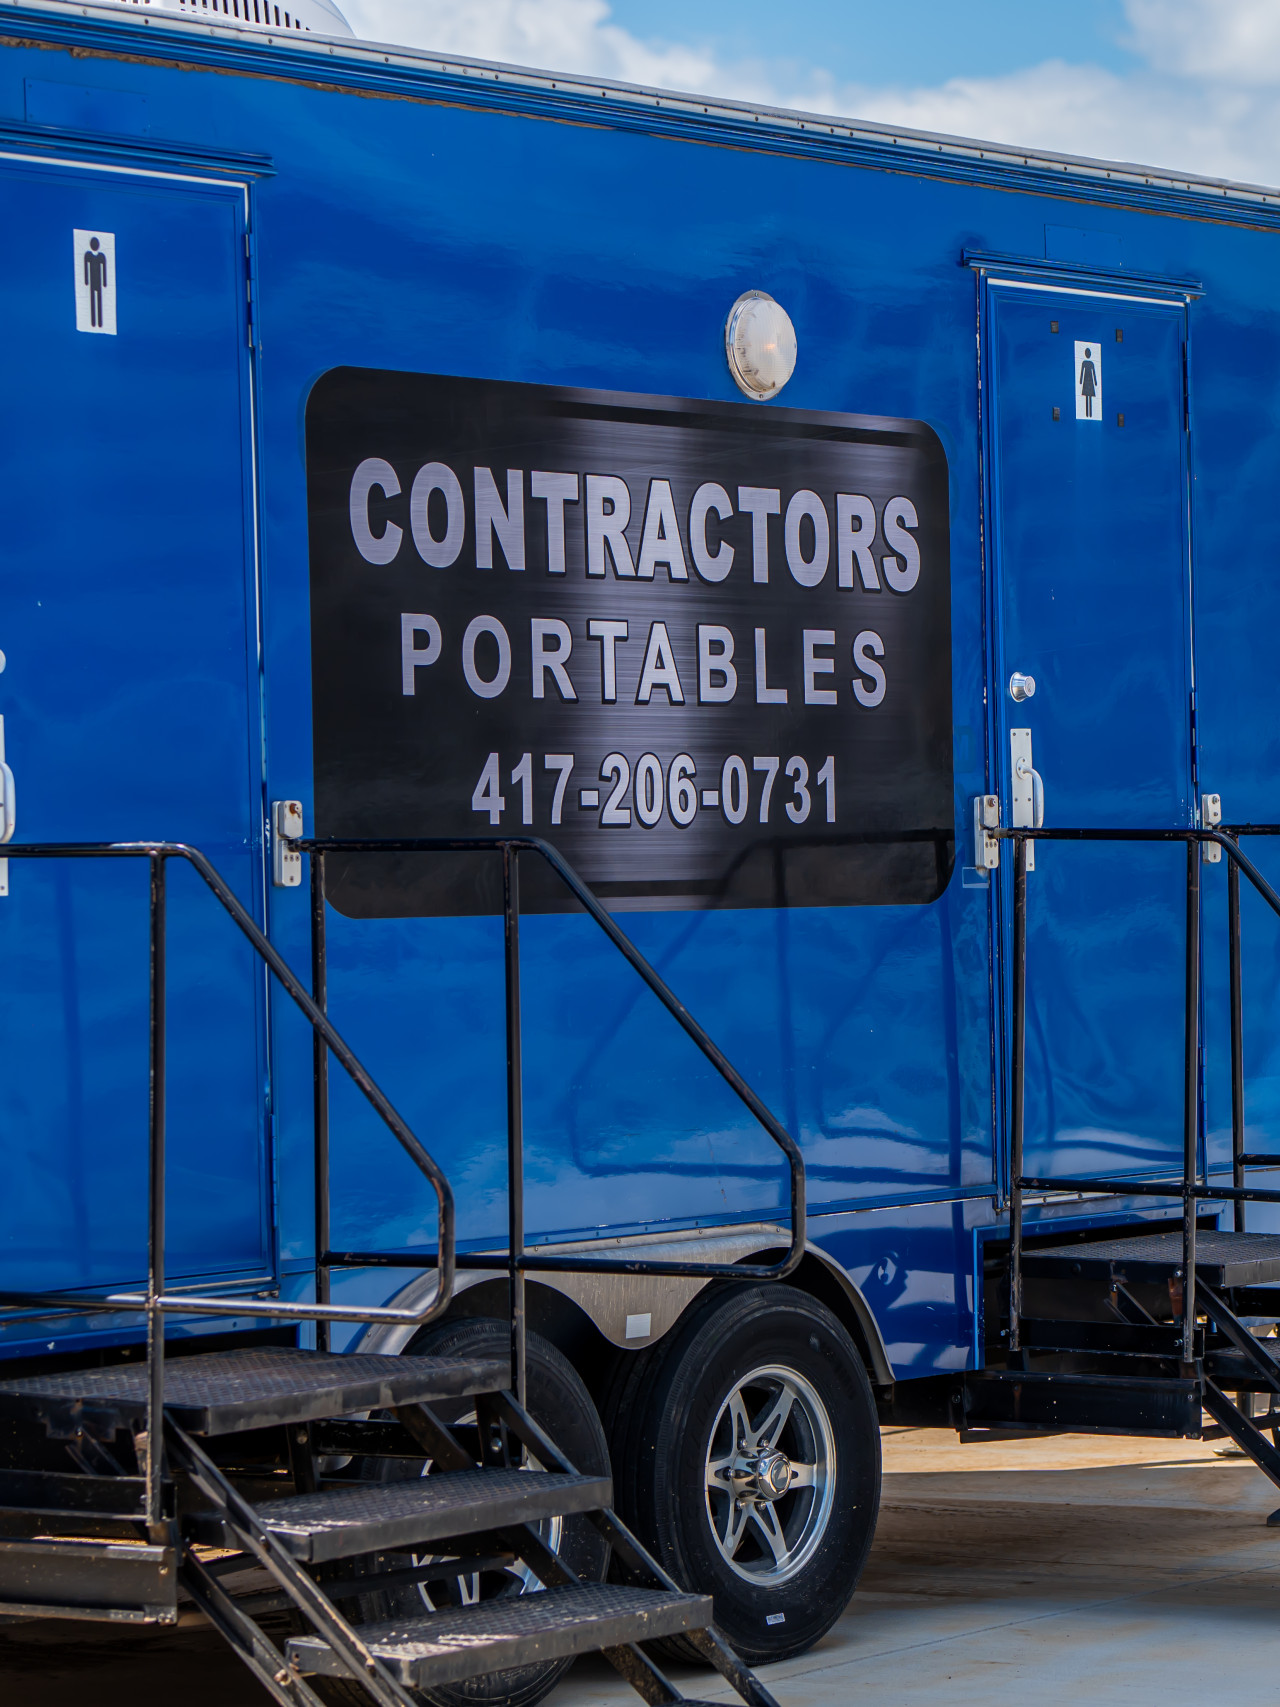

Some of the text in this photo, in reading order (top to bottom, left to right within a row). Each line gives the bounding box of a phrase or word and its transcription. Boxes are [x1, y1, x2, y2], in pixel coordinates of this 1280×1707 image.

[349, 457, 921, 593] CONTRACTORS
[400, 612, 888, 708] PORTABLES
[471, 751, 836, 826] 417-206-0731
